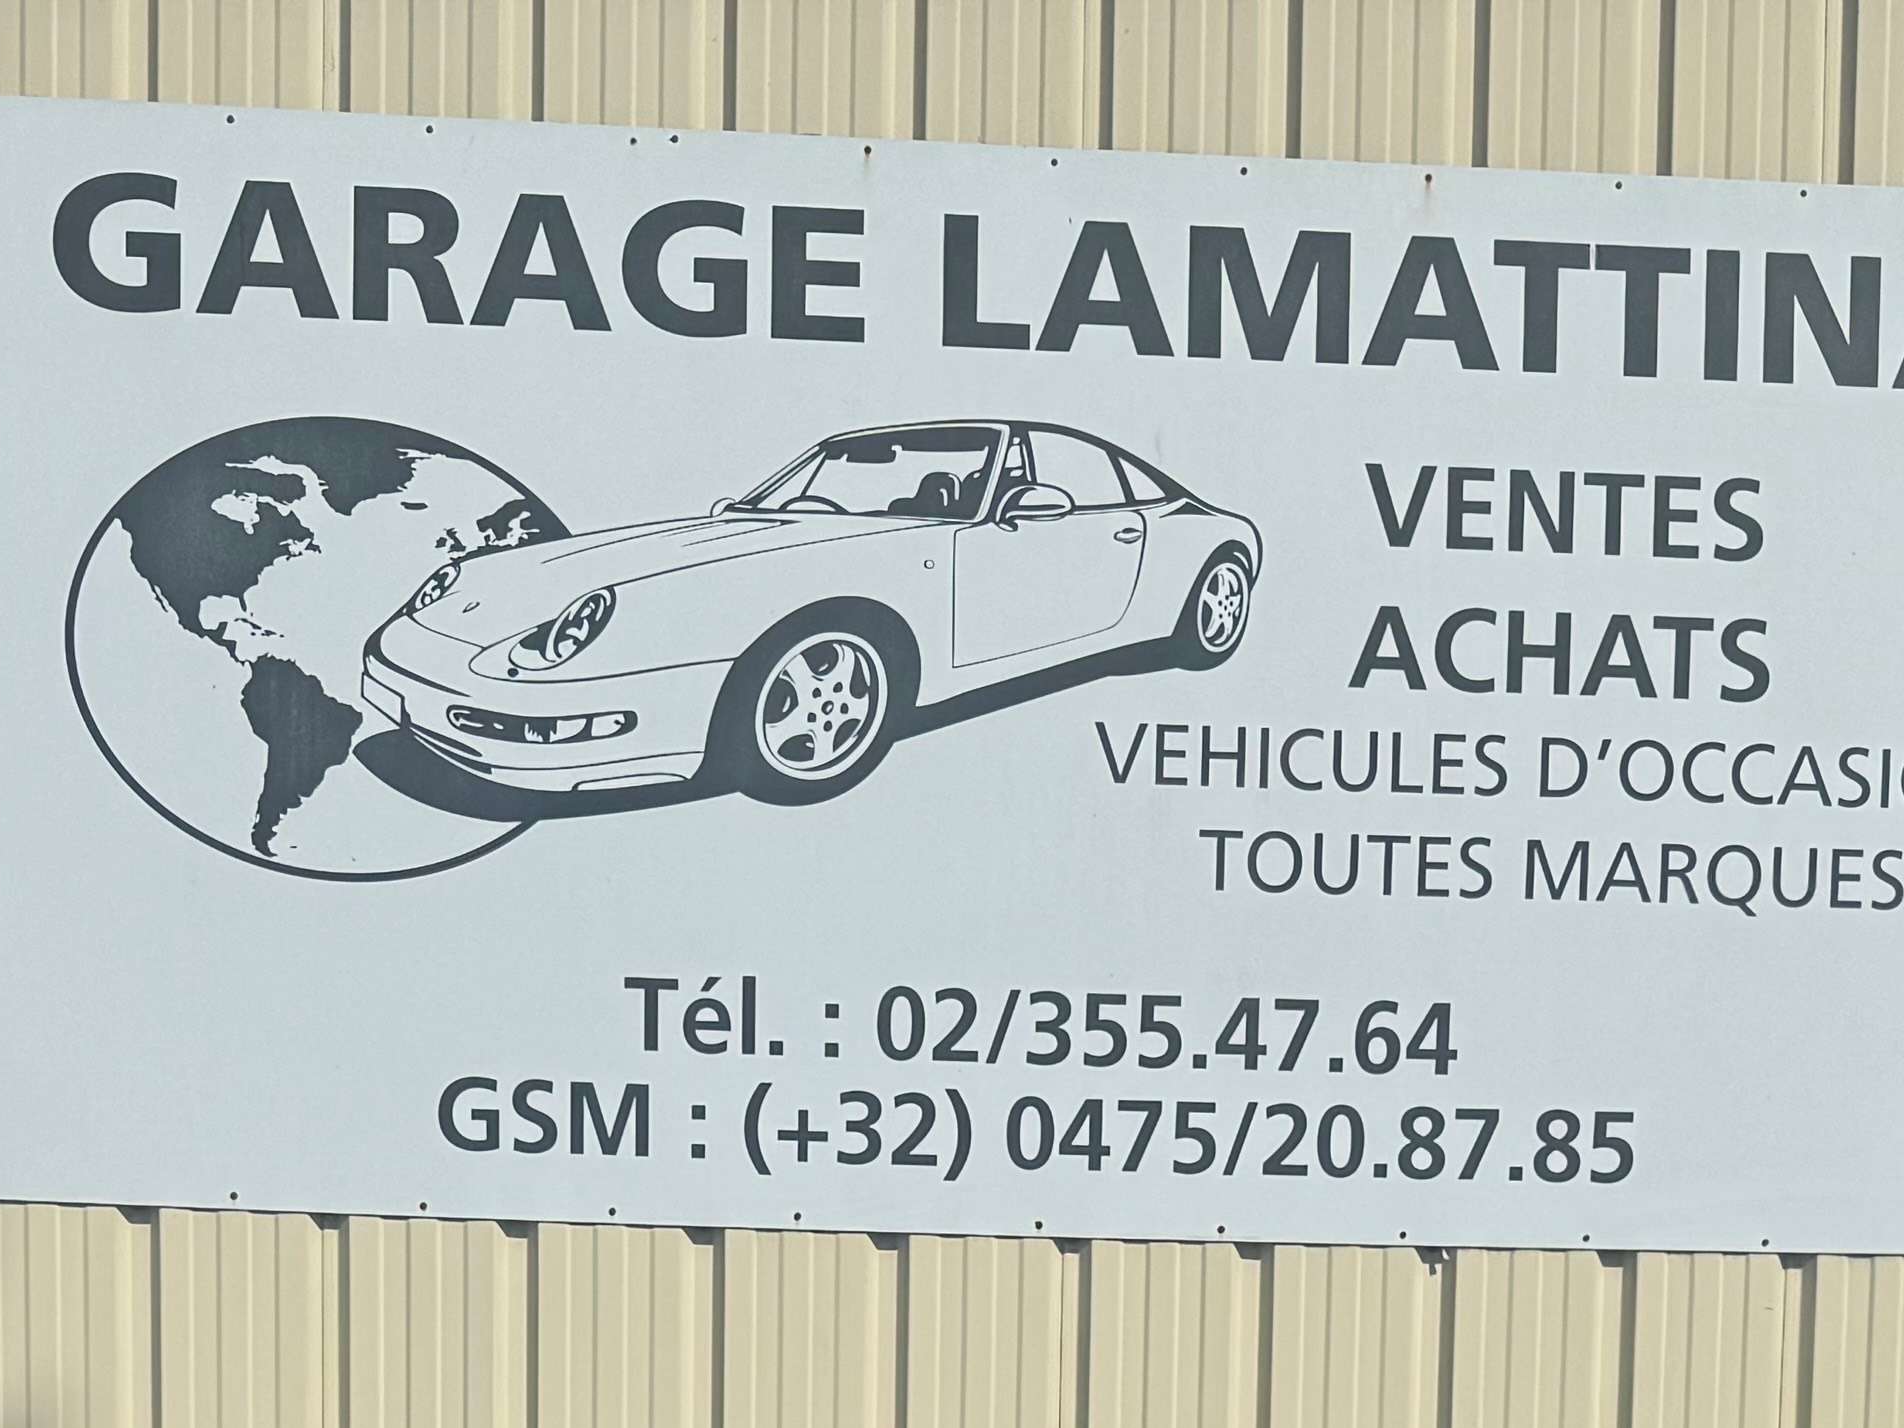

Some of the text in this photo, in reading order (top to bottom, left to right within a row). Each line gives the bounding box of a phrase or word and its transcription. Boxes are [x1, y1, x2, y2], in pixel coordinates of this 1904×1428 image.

[53, 173, 864, 343] GARAGE
[1365, 463, 1763, 561] VENTES
[1348, 606, 1769, 702] ACHATS
[1095, 722, 1507, 796] VEHICULES
[1199, 830, 1903, 917] TOUTES MARQUES
[624, 976, 783, 1055] Tél.
[877, 986, 1457, 1075] 02/355.47.64
[438, 1077, 649, 1156] GSM
[744, 1083, 971, 1181] (+32)
[1007, 1096, 1634, 1183] 0475/20.87.85
